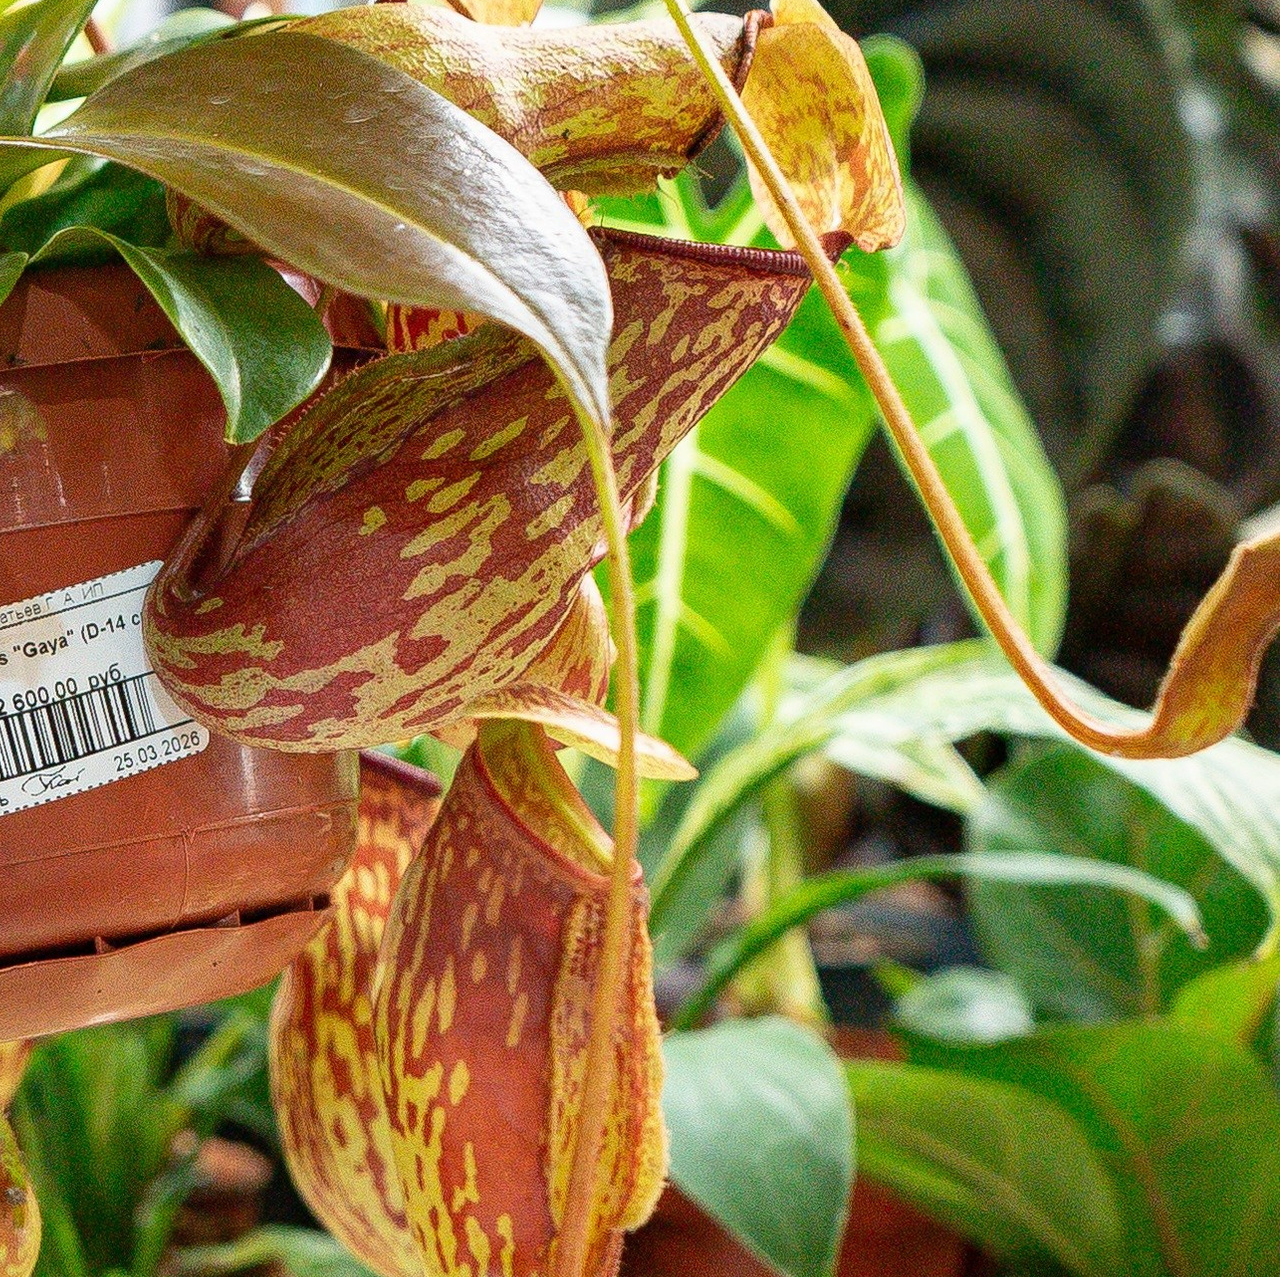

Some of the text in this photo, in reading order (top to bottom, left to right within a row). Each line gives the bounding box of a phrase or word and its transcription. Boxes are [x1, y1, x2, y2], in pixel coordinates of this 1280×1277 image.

[81, 582, 104, 600] ИП
[13, 629, 74, 658] "Gaya"
[81, 615, 126, 645] (D-14
[12, 677, 78, 712] 600,00
[88, 663, 127, 691] руб.
[113, 730, 201, 773] 25.03.2026
